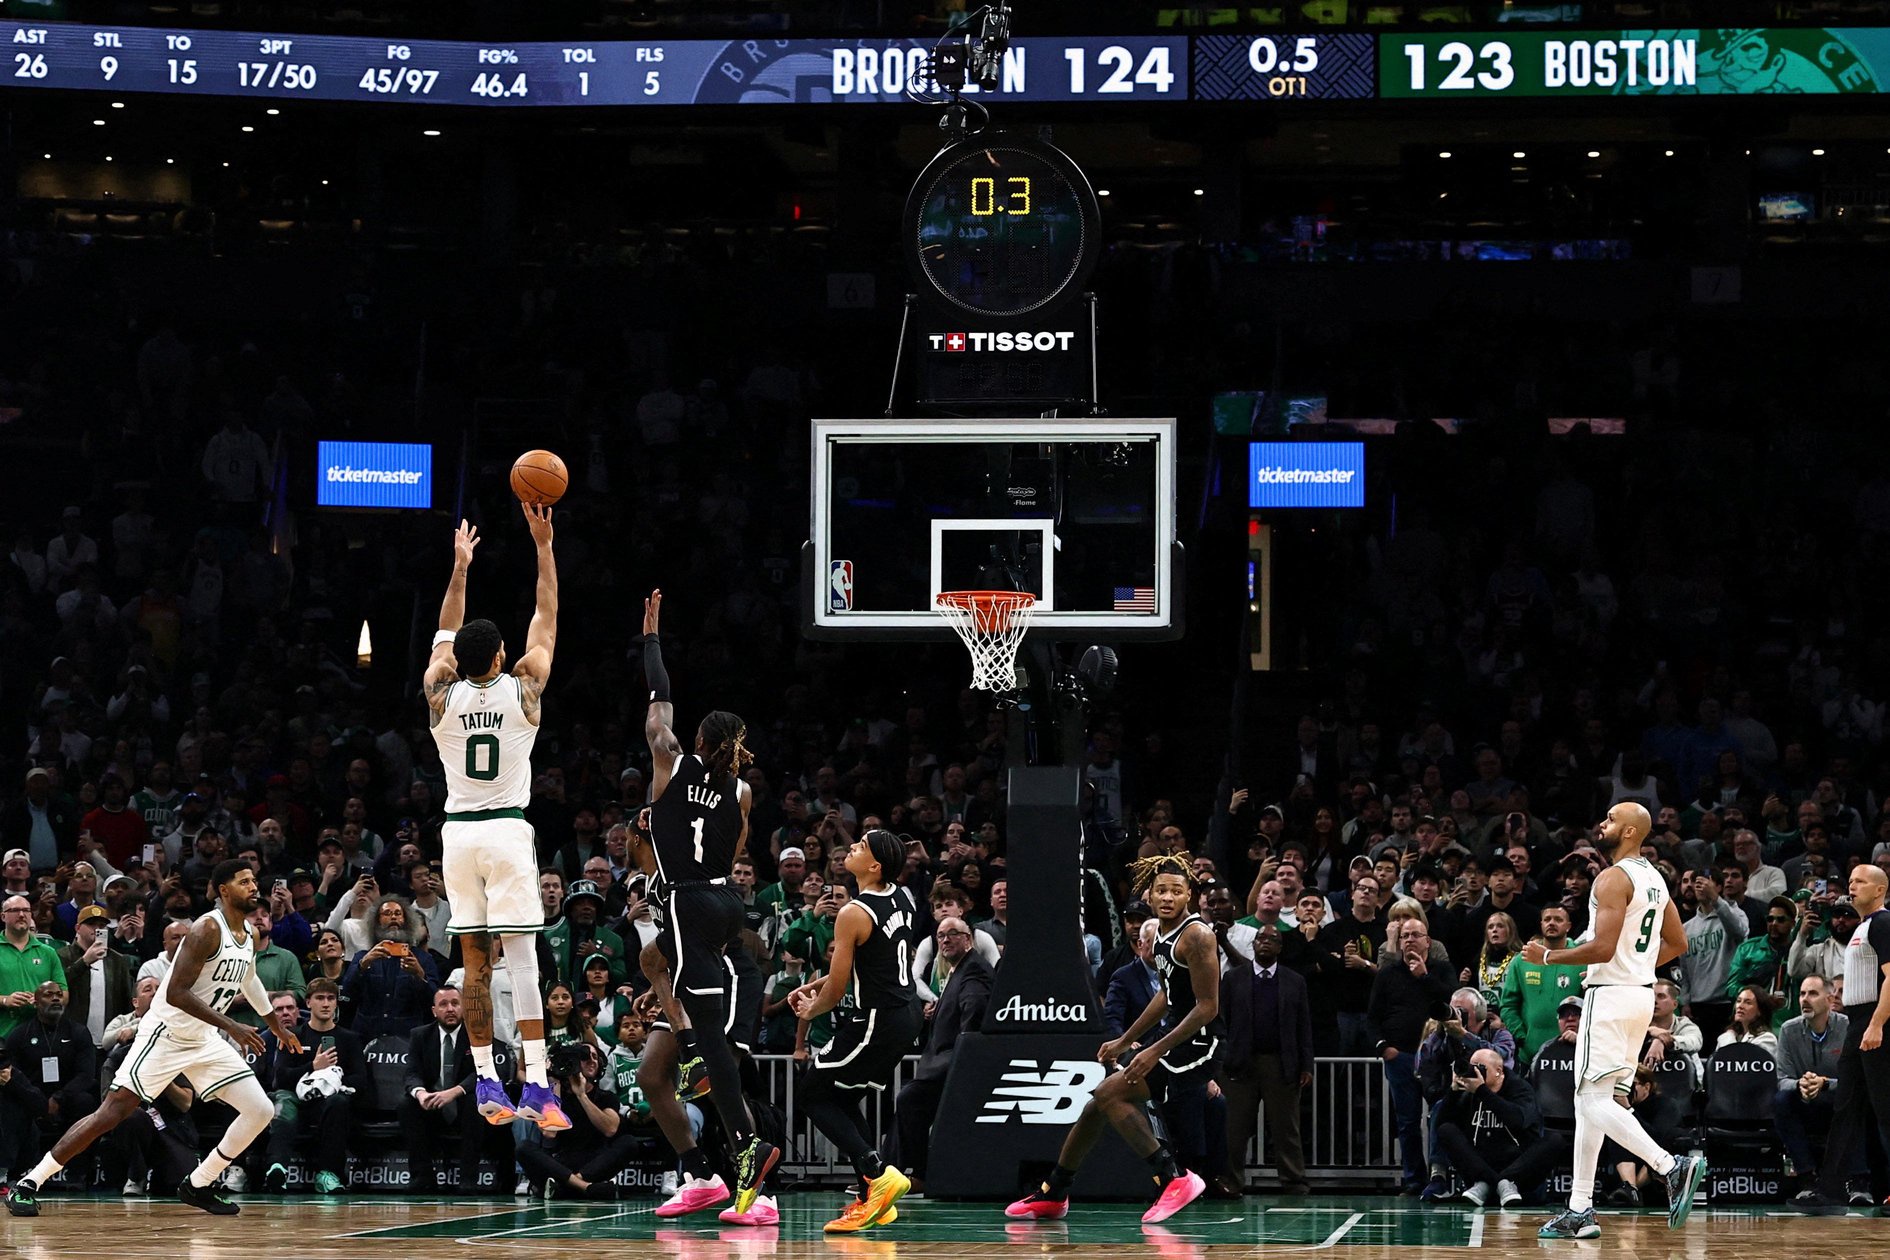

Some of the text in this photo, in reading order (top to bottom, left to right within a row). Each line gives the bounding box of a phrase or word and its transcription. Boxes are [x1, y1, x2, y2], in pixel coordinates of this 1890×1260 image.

[13, 29, 48, 44] AST
[93, 32, 123, 48] STL
[166, 35, 192, 50] TO
[259, 39, 293, 55] 3PT
[387, 45, 411, 60] FG
[478, 49, 519, 64] FG%
[562, 48, 596, 63] TOL
[636, 47, 665, 62] FLS
[1249, 37, 1319, 72] 0.5
[14, 53, 48, 79] 26
[100, 56, 119, 81] 9
[167, 59, 198, 84] 15
[237, 61, 317, 90] 17/50
[1064, 45, 1175, 93] 124
[1403, 39, 1696, 91] 123 BOSTON
[358, 67, 440, 94] 45/97
[470, 72, 528, 98] 46.4
[578, 72, 589, 96] 1
[643, 71, 660, 96] 5
[1268, 77, 1307, 96] OT1
[972, 177, 1030, 215] 0.3
[969, 332, 1074, 352] TISSOT
[326, 466, 423, 486] ticketmaster
[1258, 466, 1355, 486] ticketmaster
[459, 711, 504, 730] TATUM
[465, 734, 500, 781] 0
[687, 784, 722, 810] ELLIS
[690, 817, 705, 864] 1
[1635, 908, 1656, 953] 9
[897, 939, 909, 987] 0
[995, 994, 1088, 1022] Amica
[367, 1052, 408, 1065] PIMC
[1540, 1058, 1573, 1071] PIM
[1714, 1059, 1775, 1072] PIMCO
[617, 1069, 638, 1088] BOS
[628, 1087, 643, 1104] 0
[975, 1059, 1107, 1125] NB
[349, 1166, 411, 1186] jetBlue
[1711, 1175, 1778, 1198] jetBlue
